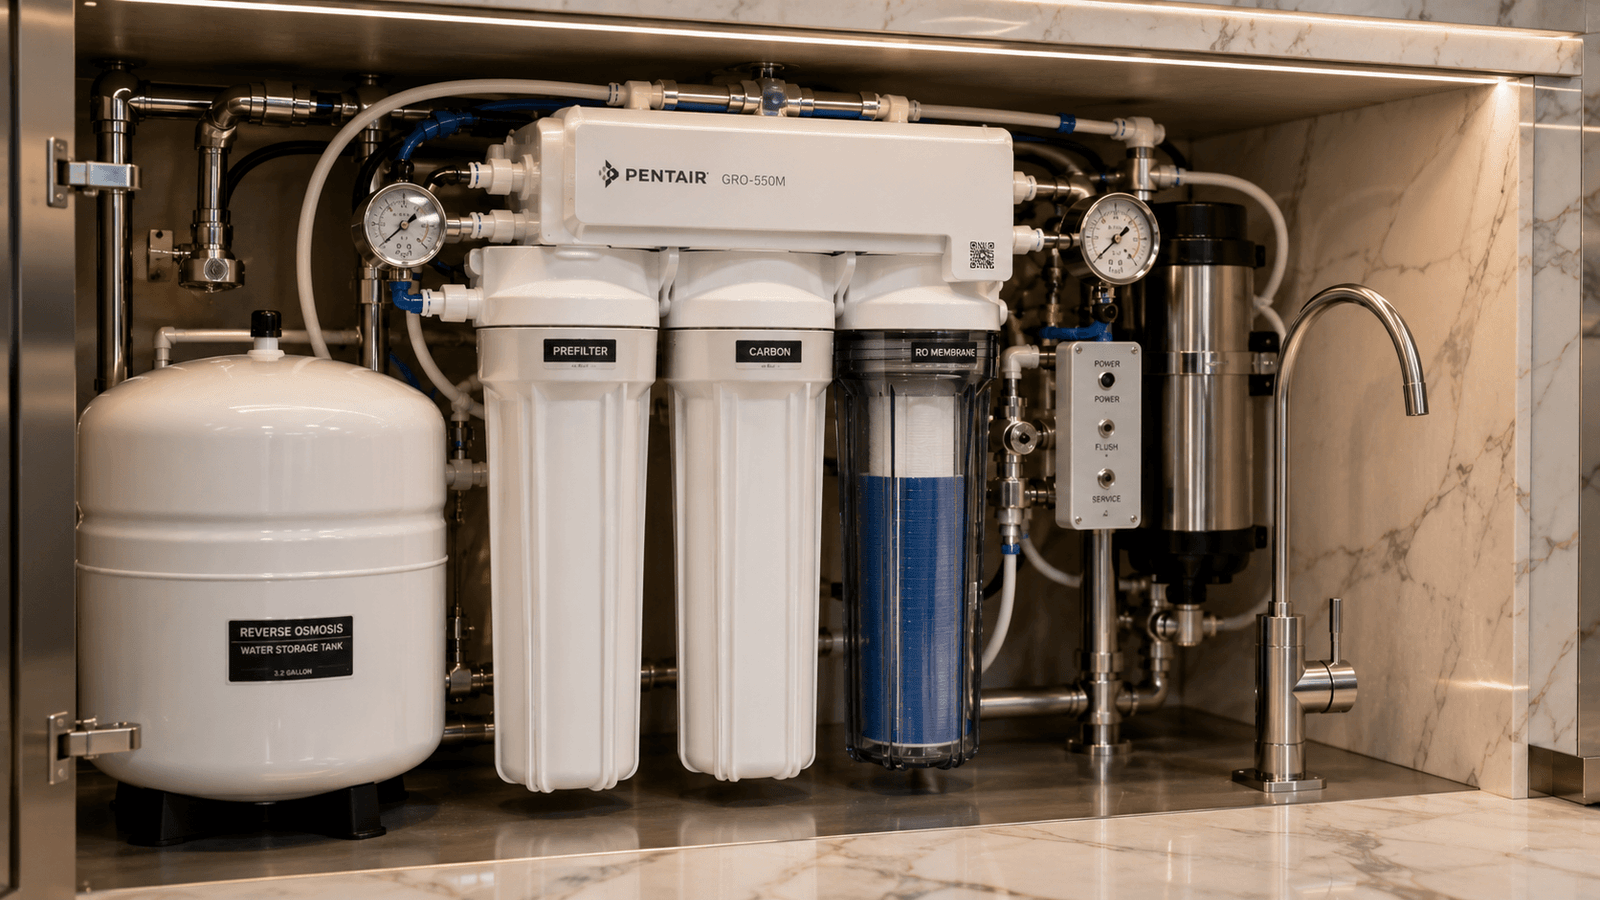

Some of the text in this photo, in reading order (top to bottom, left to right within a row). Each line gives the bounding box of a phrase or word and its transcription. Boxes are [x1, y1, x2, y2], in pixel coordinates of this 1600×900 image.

[625, 168, 786, 187] PENTAIR GRO-550M
[553, 346, 608, 356] PREFILTER
[749, 347, 791, 356] CARBON
[915, 348, 976, 357] RO MEMBRANE
[1094, 360, 1120, 368] POWER
[1094, 395, 1120, 403] POWER
[1095, 443, 1119, 451] FLUSH
[1092, 495, 1121, 504] SERVICE
[240, 623, 344, 638] REVERSE OSMOSIS
[240, 641, 344, 655] WATER STORAGE TANK
[286, 668, 313, 676] GALLON
